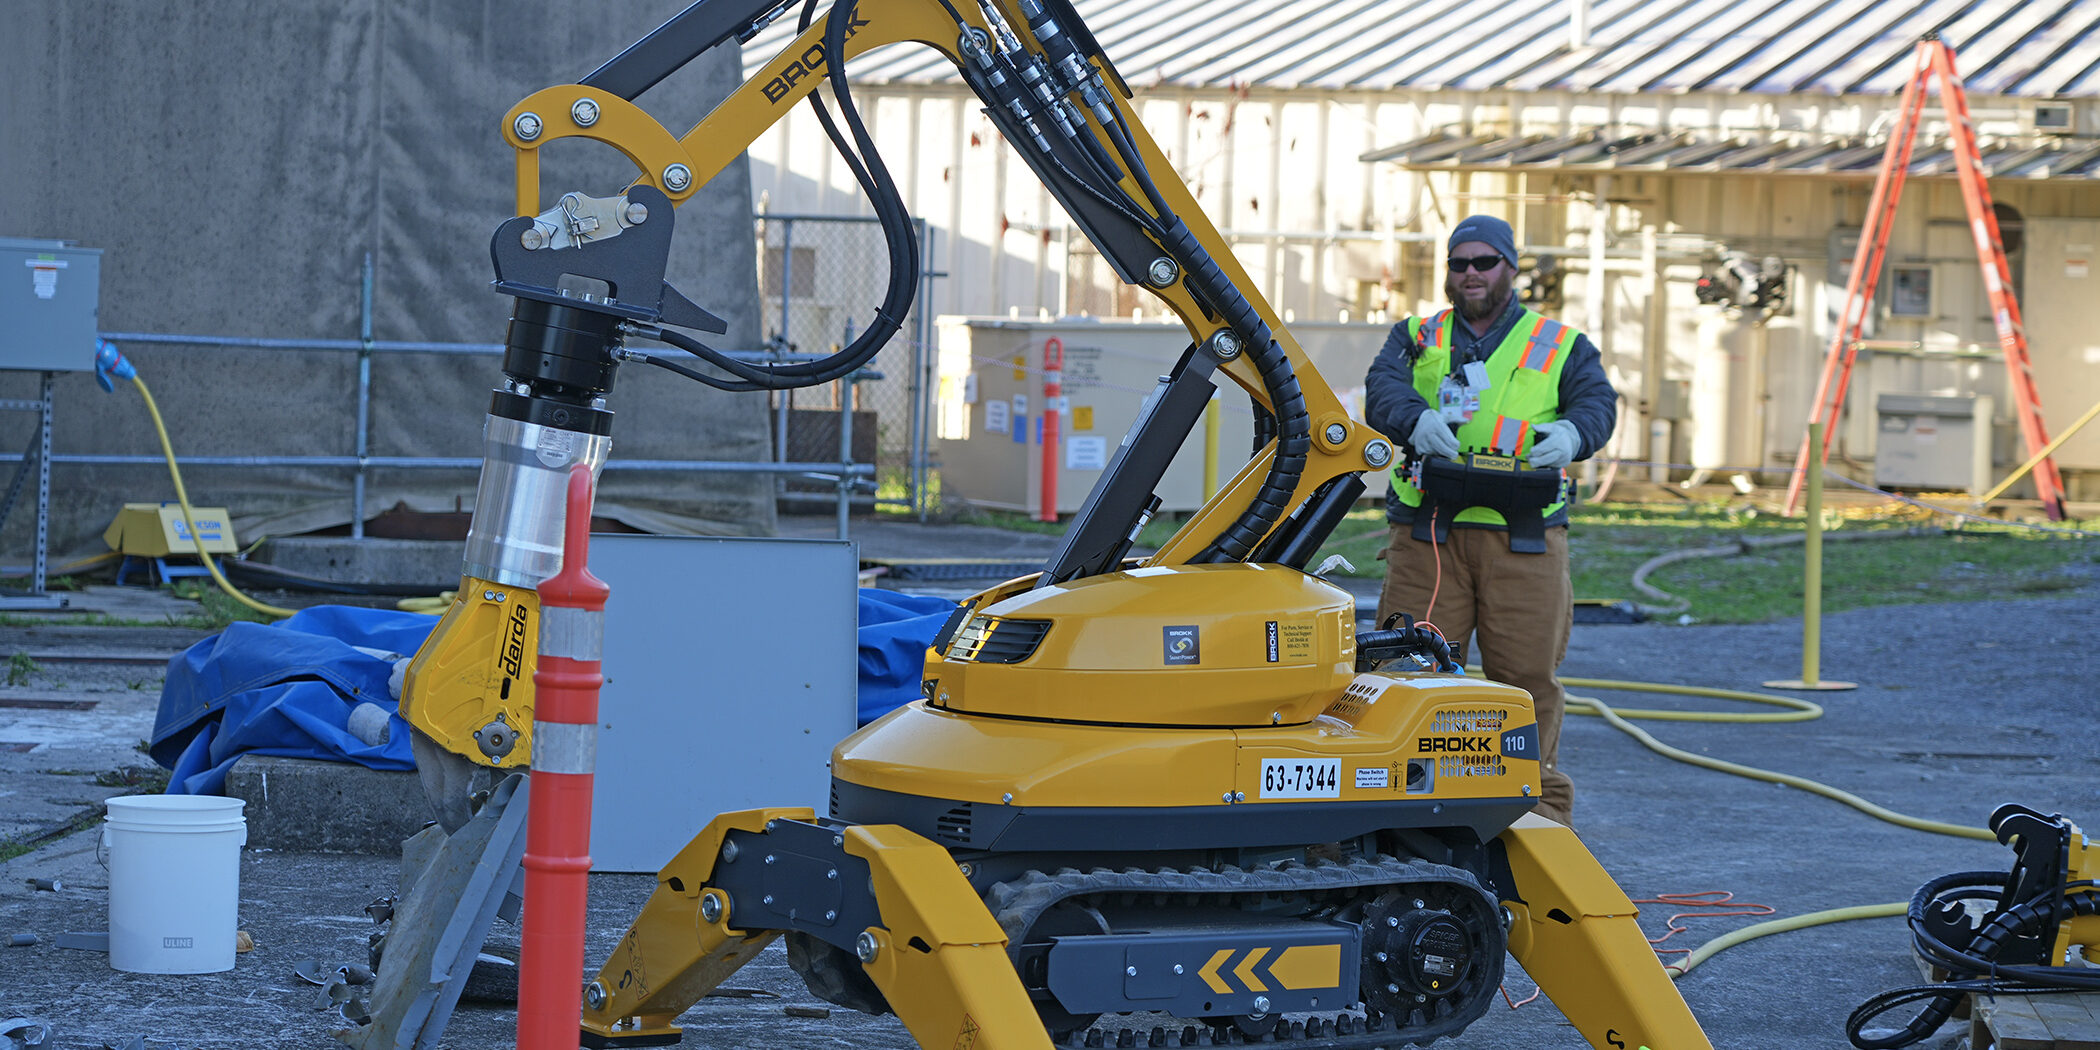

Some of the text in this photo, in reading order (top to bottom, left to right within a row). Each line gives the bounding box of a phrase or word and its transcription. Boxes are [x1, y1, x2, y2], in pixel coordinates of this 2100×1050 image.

[760, 6, 871, 105] BROK
[504, 603, 527, 677] darda
[1269, 622, 1277, 661] BROKK
[1418, 735, 1525, 752] BROKK 110
[1265, 764, 1336, 792] 63-7344
[164, 938, 192, 948] ULINE
